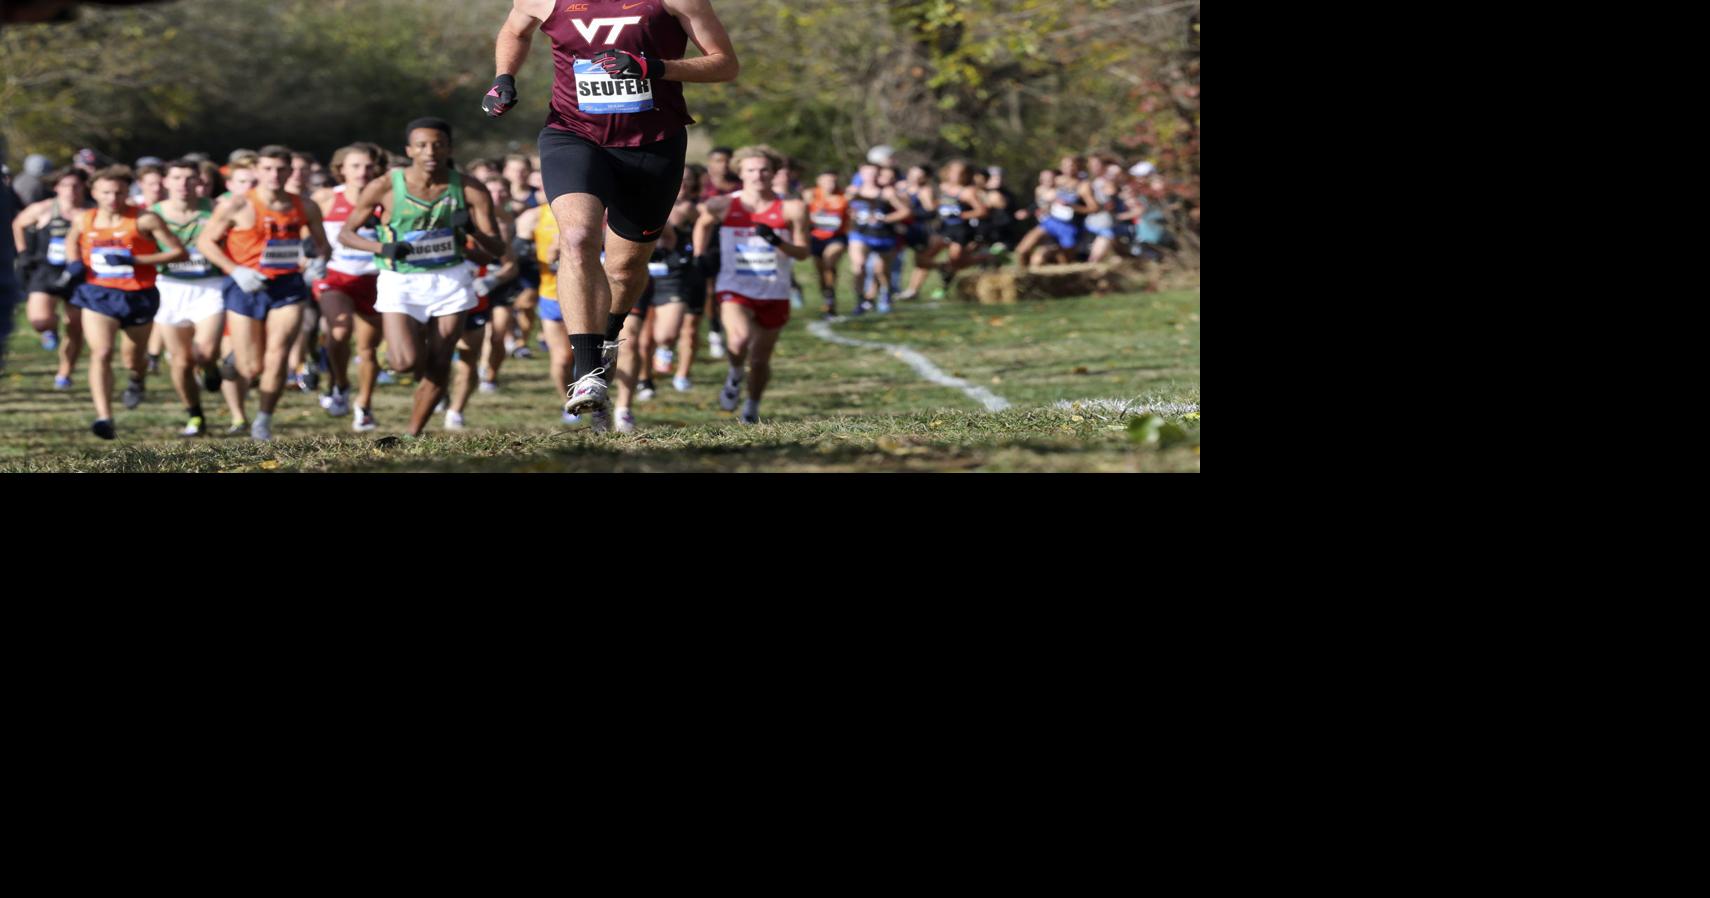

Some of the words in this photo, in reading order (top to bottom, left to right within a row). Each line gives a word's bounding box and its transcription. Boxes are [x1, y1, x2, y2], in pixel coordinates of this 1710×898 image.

[566, 3, 589, 11] ACC
[571, 16, 642, 45] VT
[578, 79, 650, 97] SEUFER
